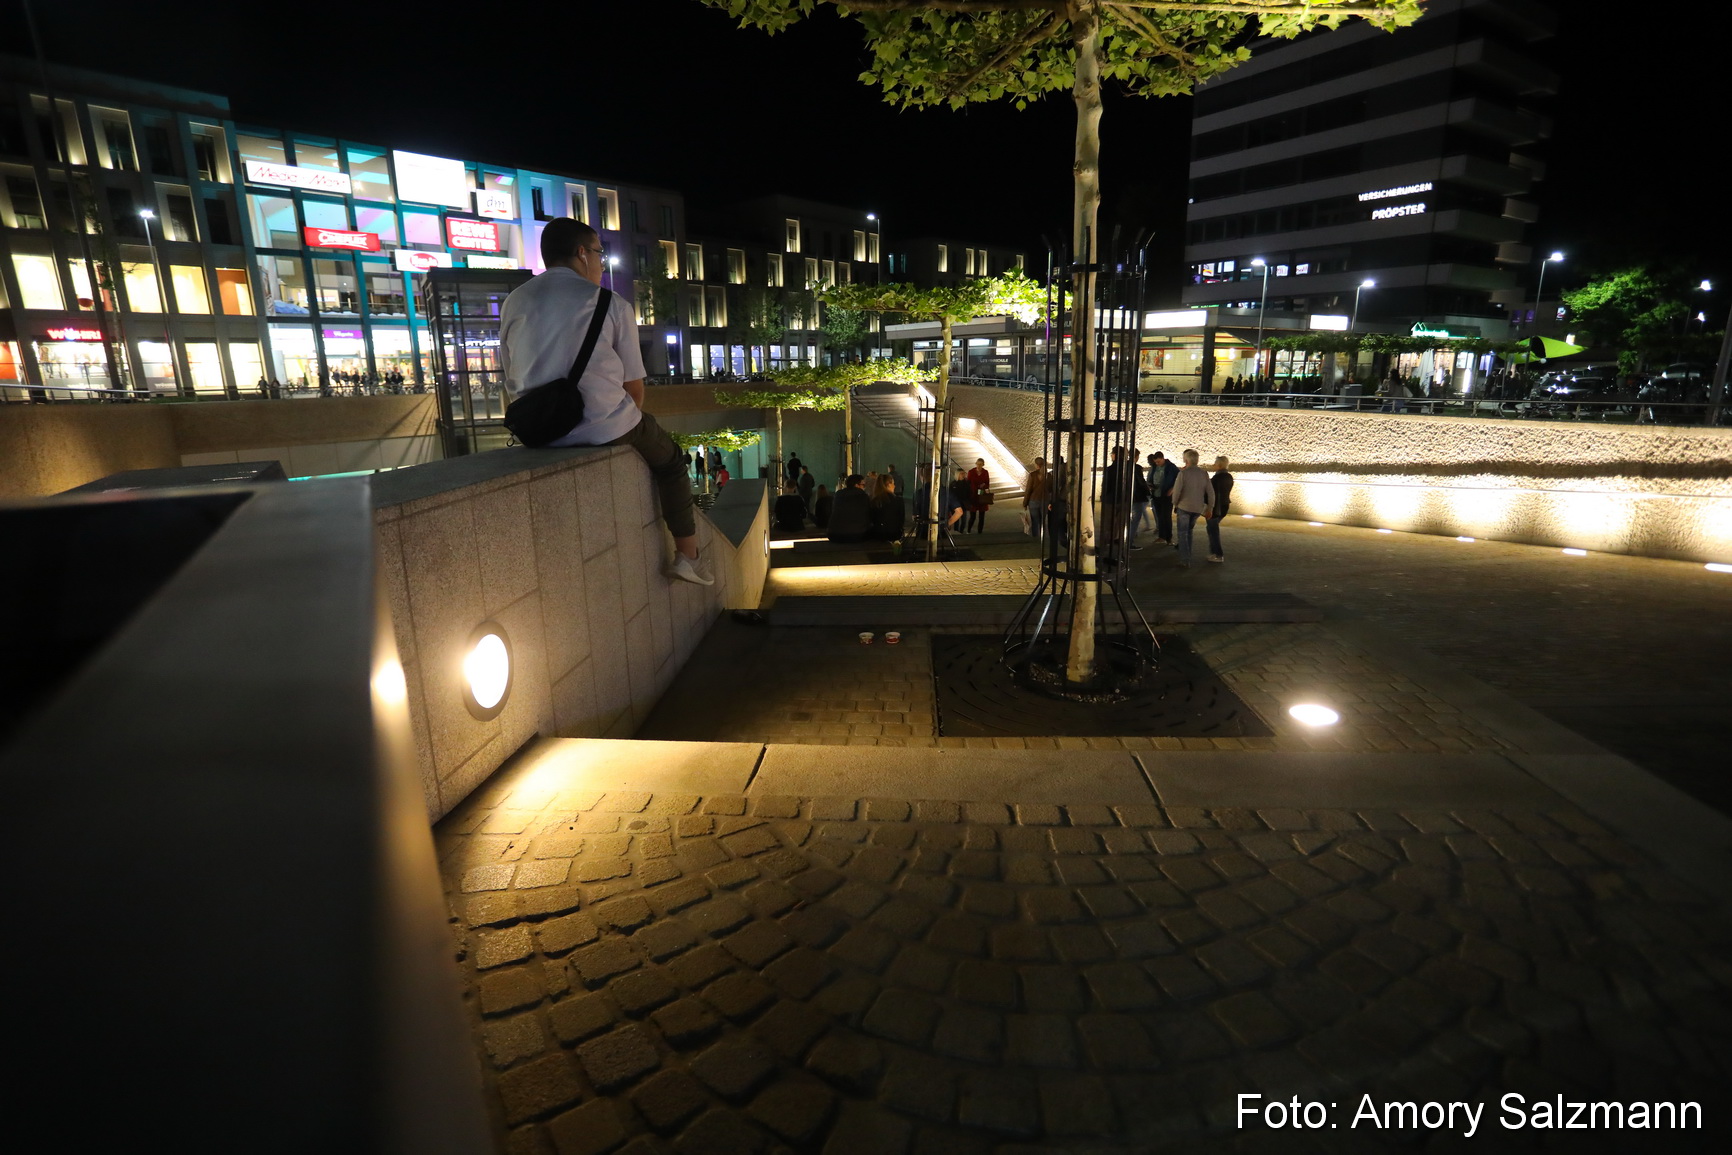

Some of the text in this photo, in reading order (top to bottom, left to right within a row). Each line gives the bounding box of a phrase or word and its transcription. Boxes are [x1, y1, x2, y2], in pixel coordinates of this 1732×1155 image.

[1358, 182, 1433, 201] VERSICHERUNGEN
[486, 196, 505, 209] dm
[1372, 203, 1426, 220] PRÖPSTER
[449, 220, 496, 239] REWE
[318, 231, 368, 247] CINEPLEX
[452, 236, 497, 250] CENTER
